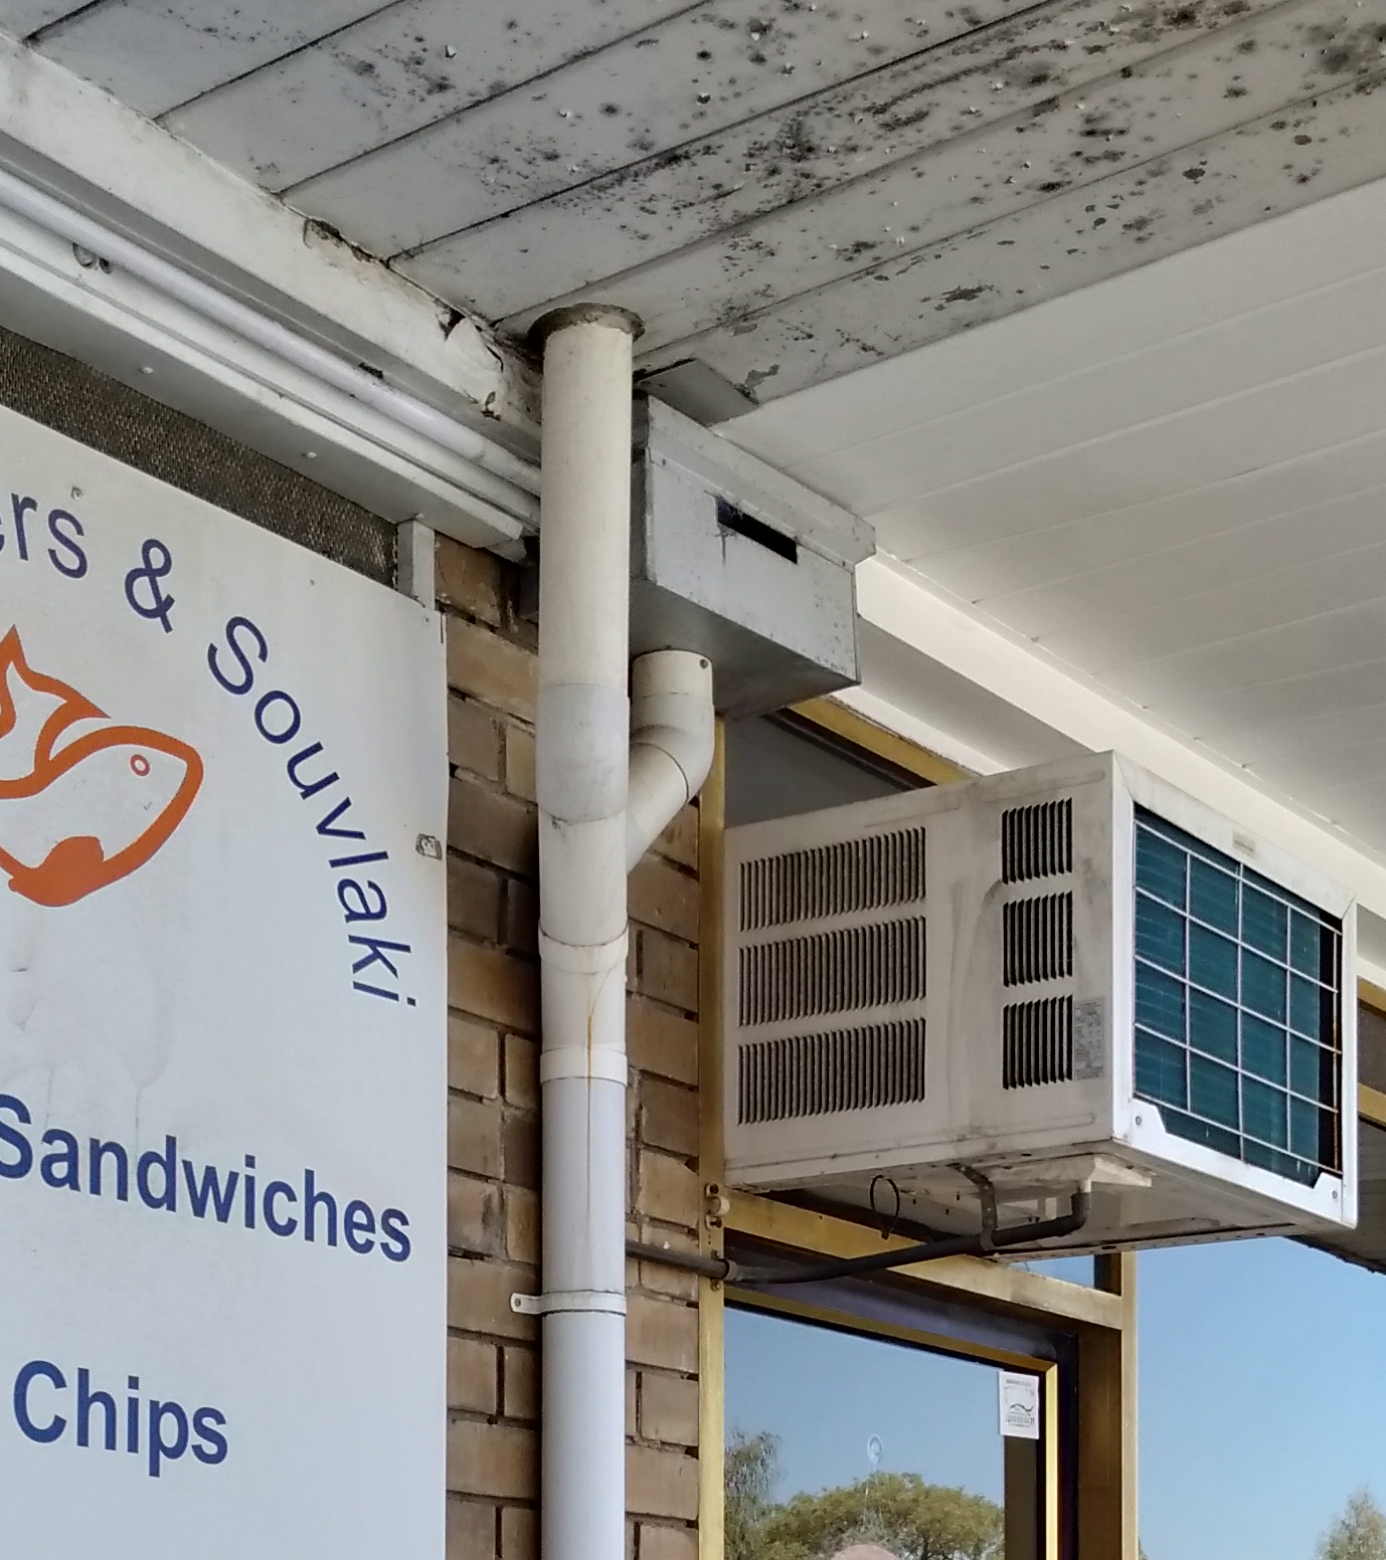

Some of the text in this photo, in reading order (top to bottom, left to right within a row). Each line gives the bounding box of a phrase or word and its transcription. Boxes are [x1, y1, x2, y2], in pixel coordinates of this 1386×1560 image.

[125, 539, 175, 633] &
[207, 616, 416, 1007] Souvlaki
[14, 1360, 227, 1477] Chips
